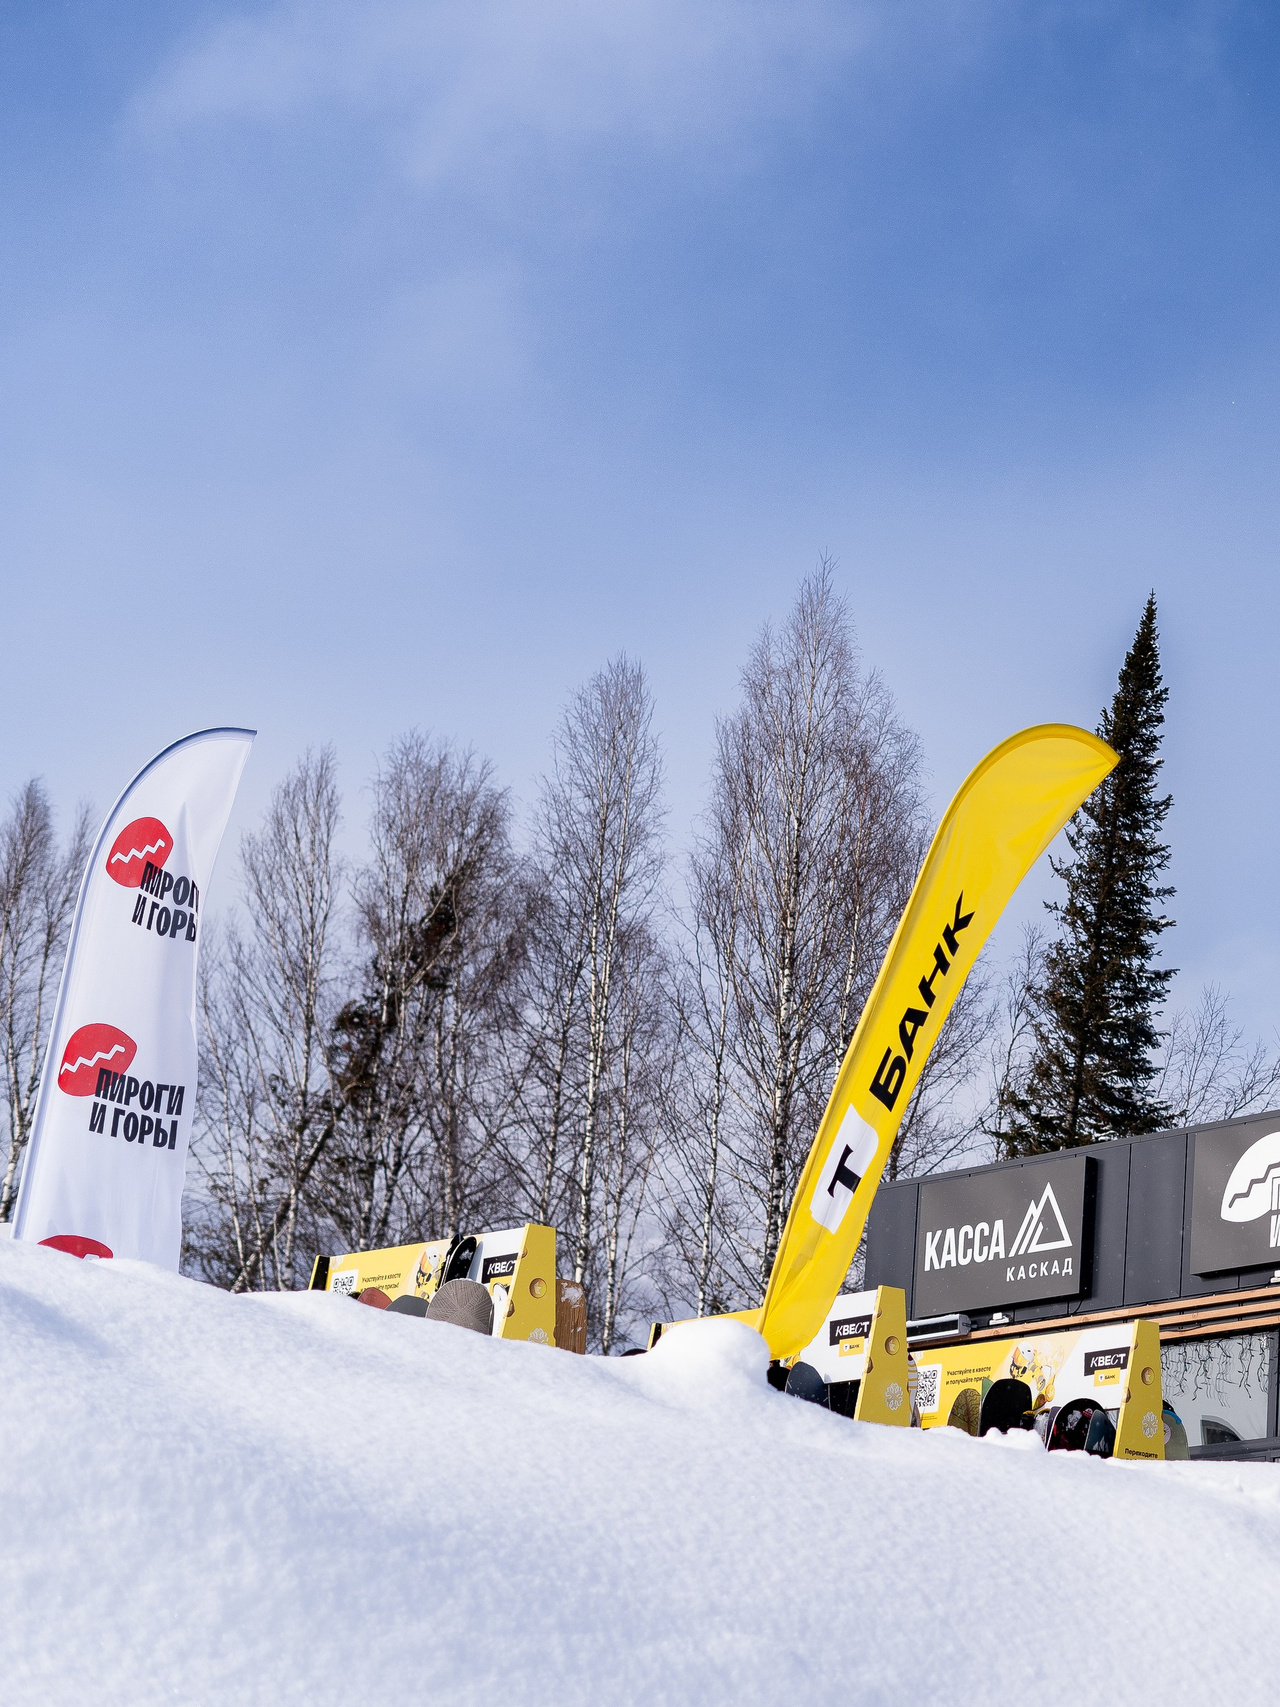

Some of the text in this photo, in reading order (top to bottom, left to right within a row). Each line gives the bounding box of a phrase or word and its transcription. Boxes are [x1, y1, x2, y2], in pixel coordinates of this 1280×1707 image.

[131, 893, 147, 926] И
[869, 889, 975, 1112] БАНК
[95, 1067, 185, 1115] ПИРОГИ
[89, 1101, 178, 1149] И ГОРЫ
[924, 1219, 1006, 1272] КАССА
[1006, 1257, 1073, 1282] КАСКАД
[835, 1321, 870, 1337] КВЕСТ
[1090, 1353, 1126, 1368] КВЕСТ
[1124, 1447, 1159, 1459] Переходите
